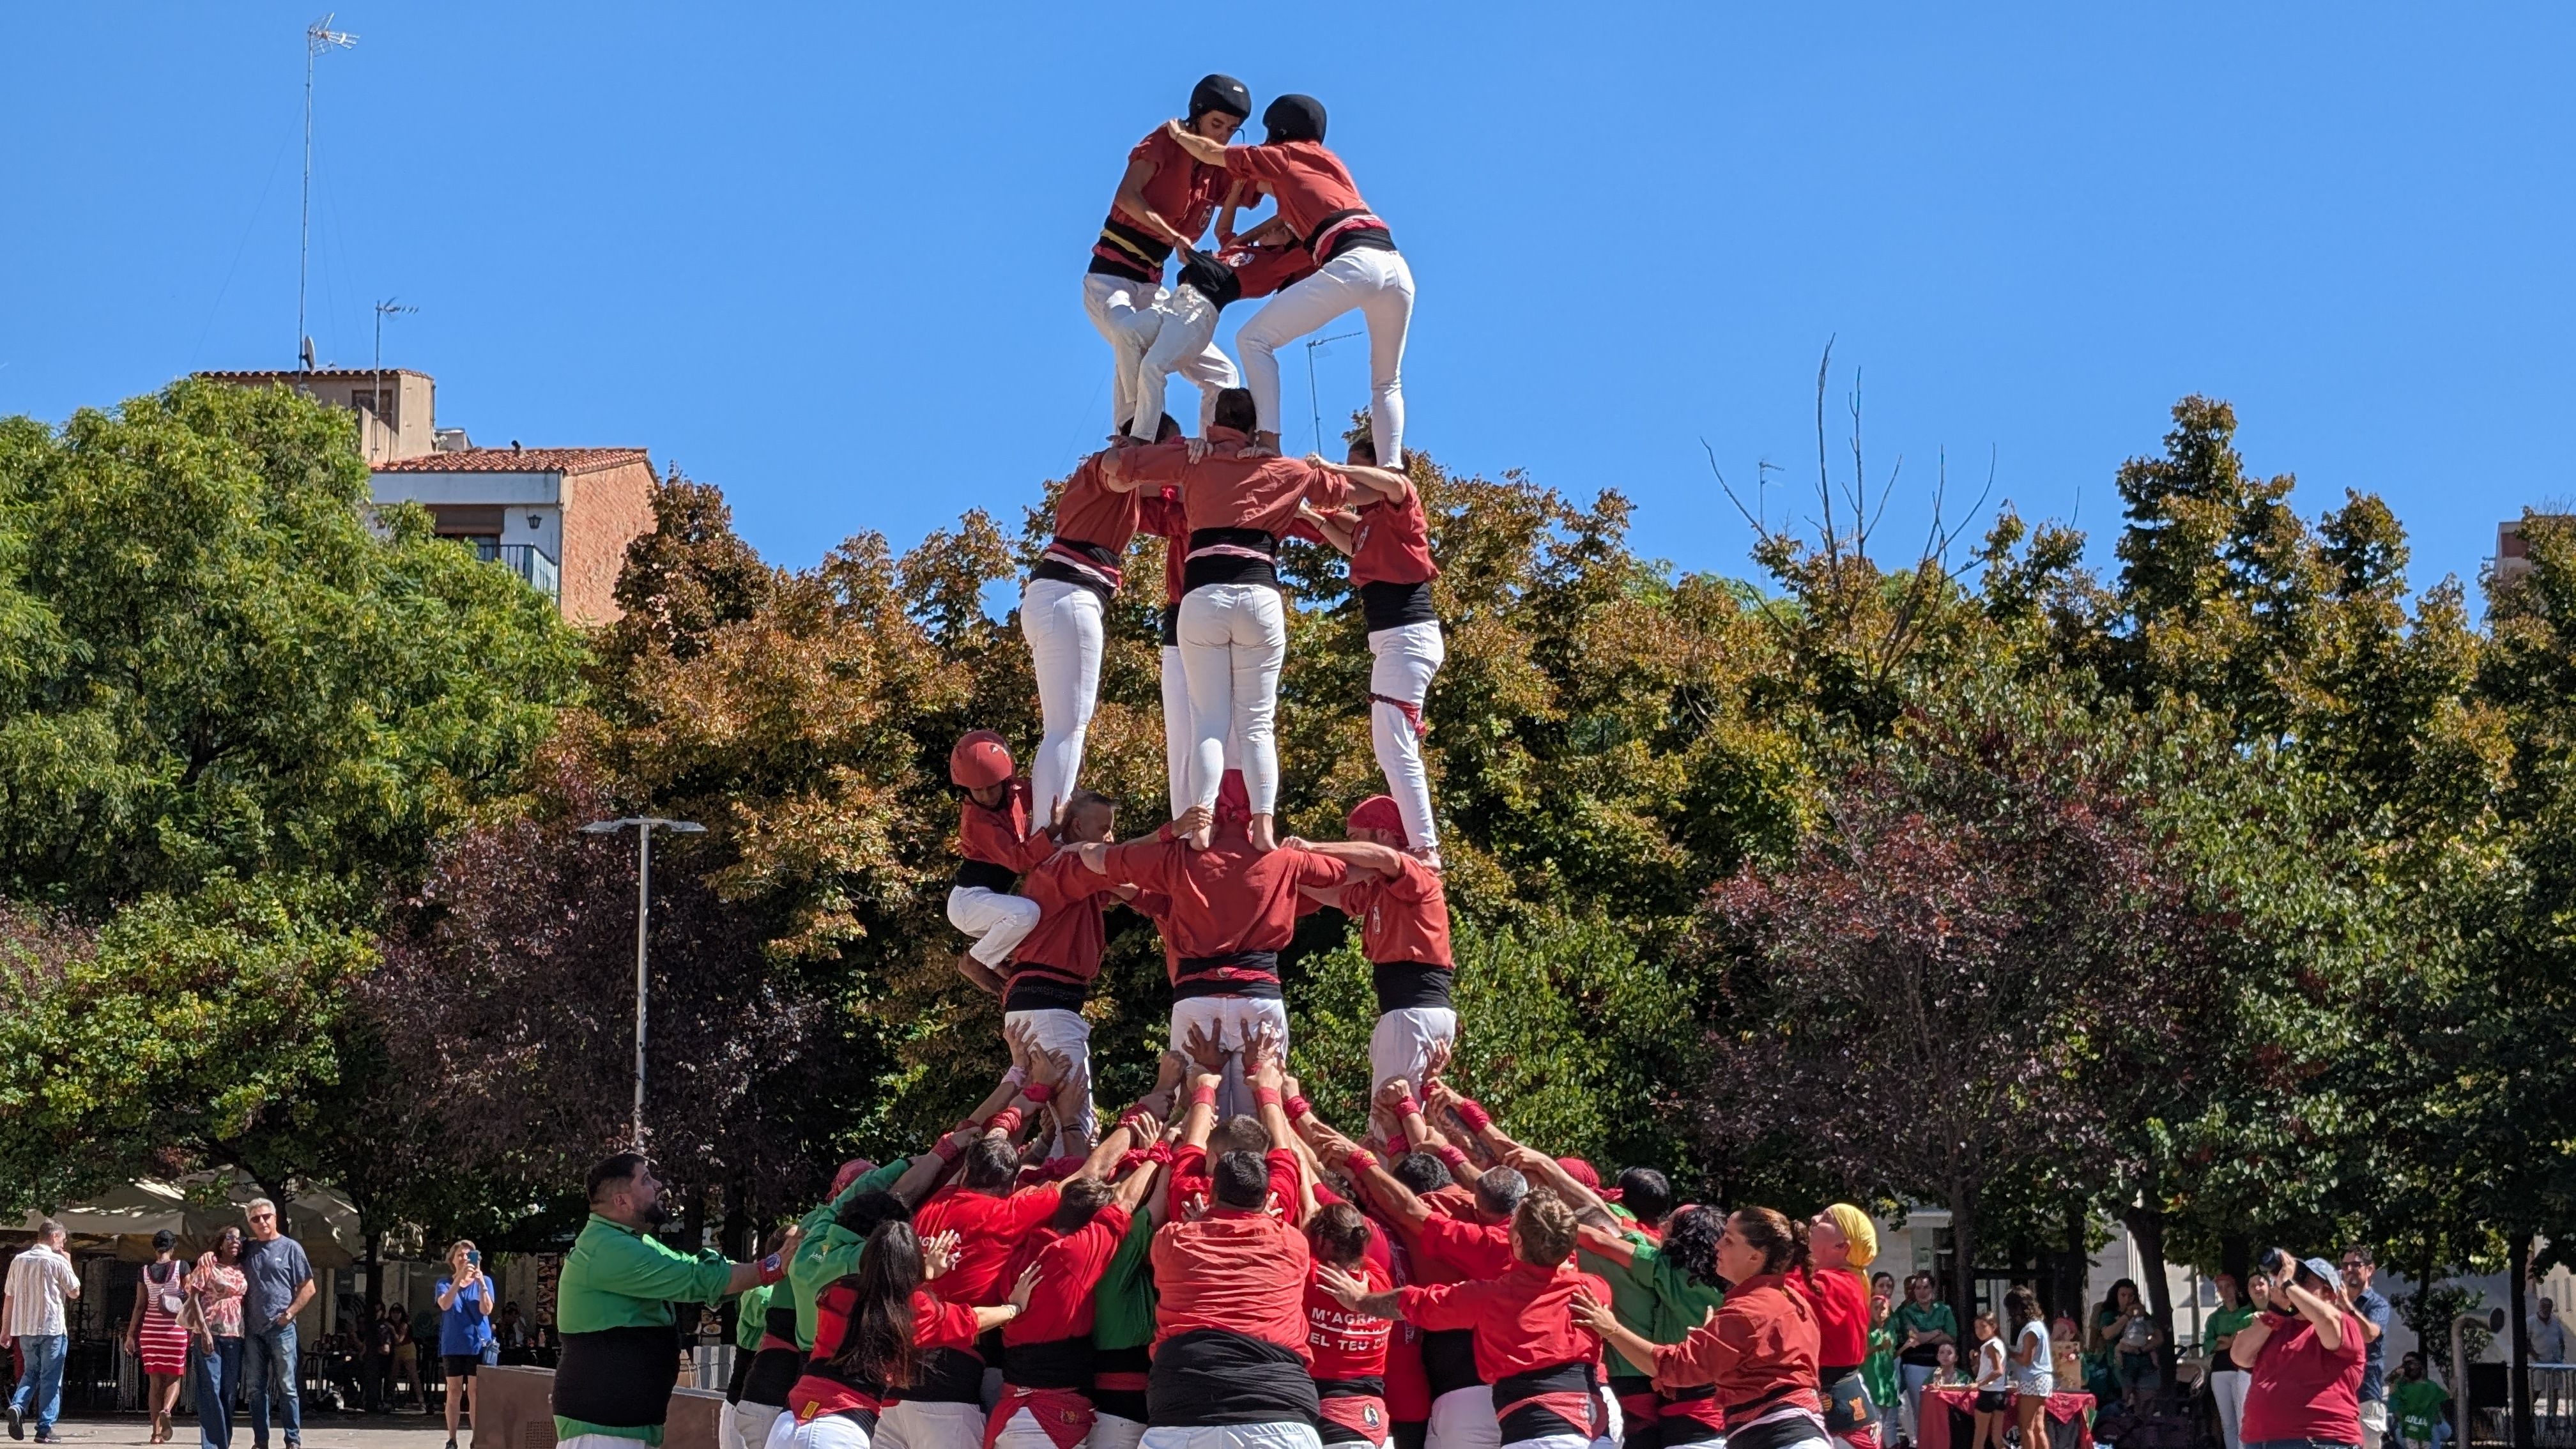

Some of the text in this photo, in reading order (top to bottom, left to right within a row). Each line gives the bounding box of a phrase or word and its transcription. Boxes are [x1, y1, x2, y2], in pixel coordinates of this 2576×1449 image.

[1312, 1307, 1384, 1325] M'AGRA
[1310, 1332, 1330, 1347] EL
[1337, 1339, 1369, 1351] TEU
